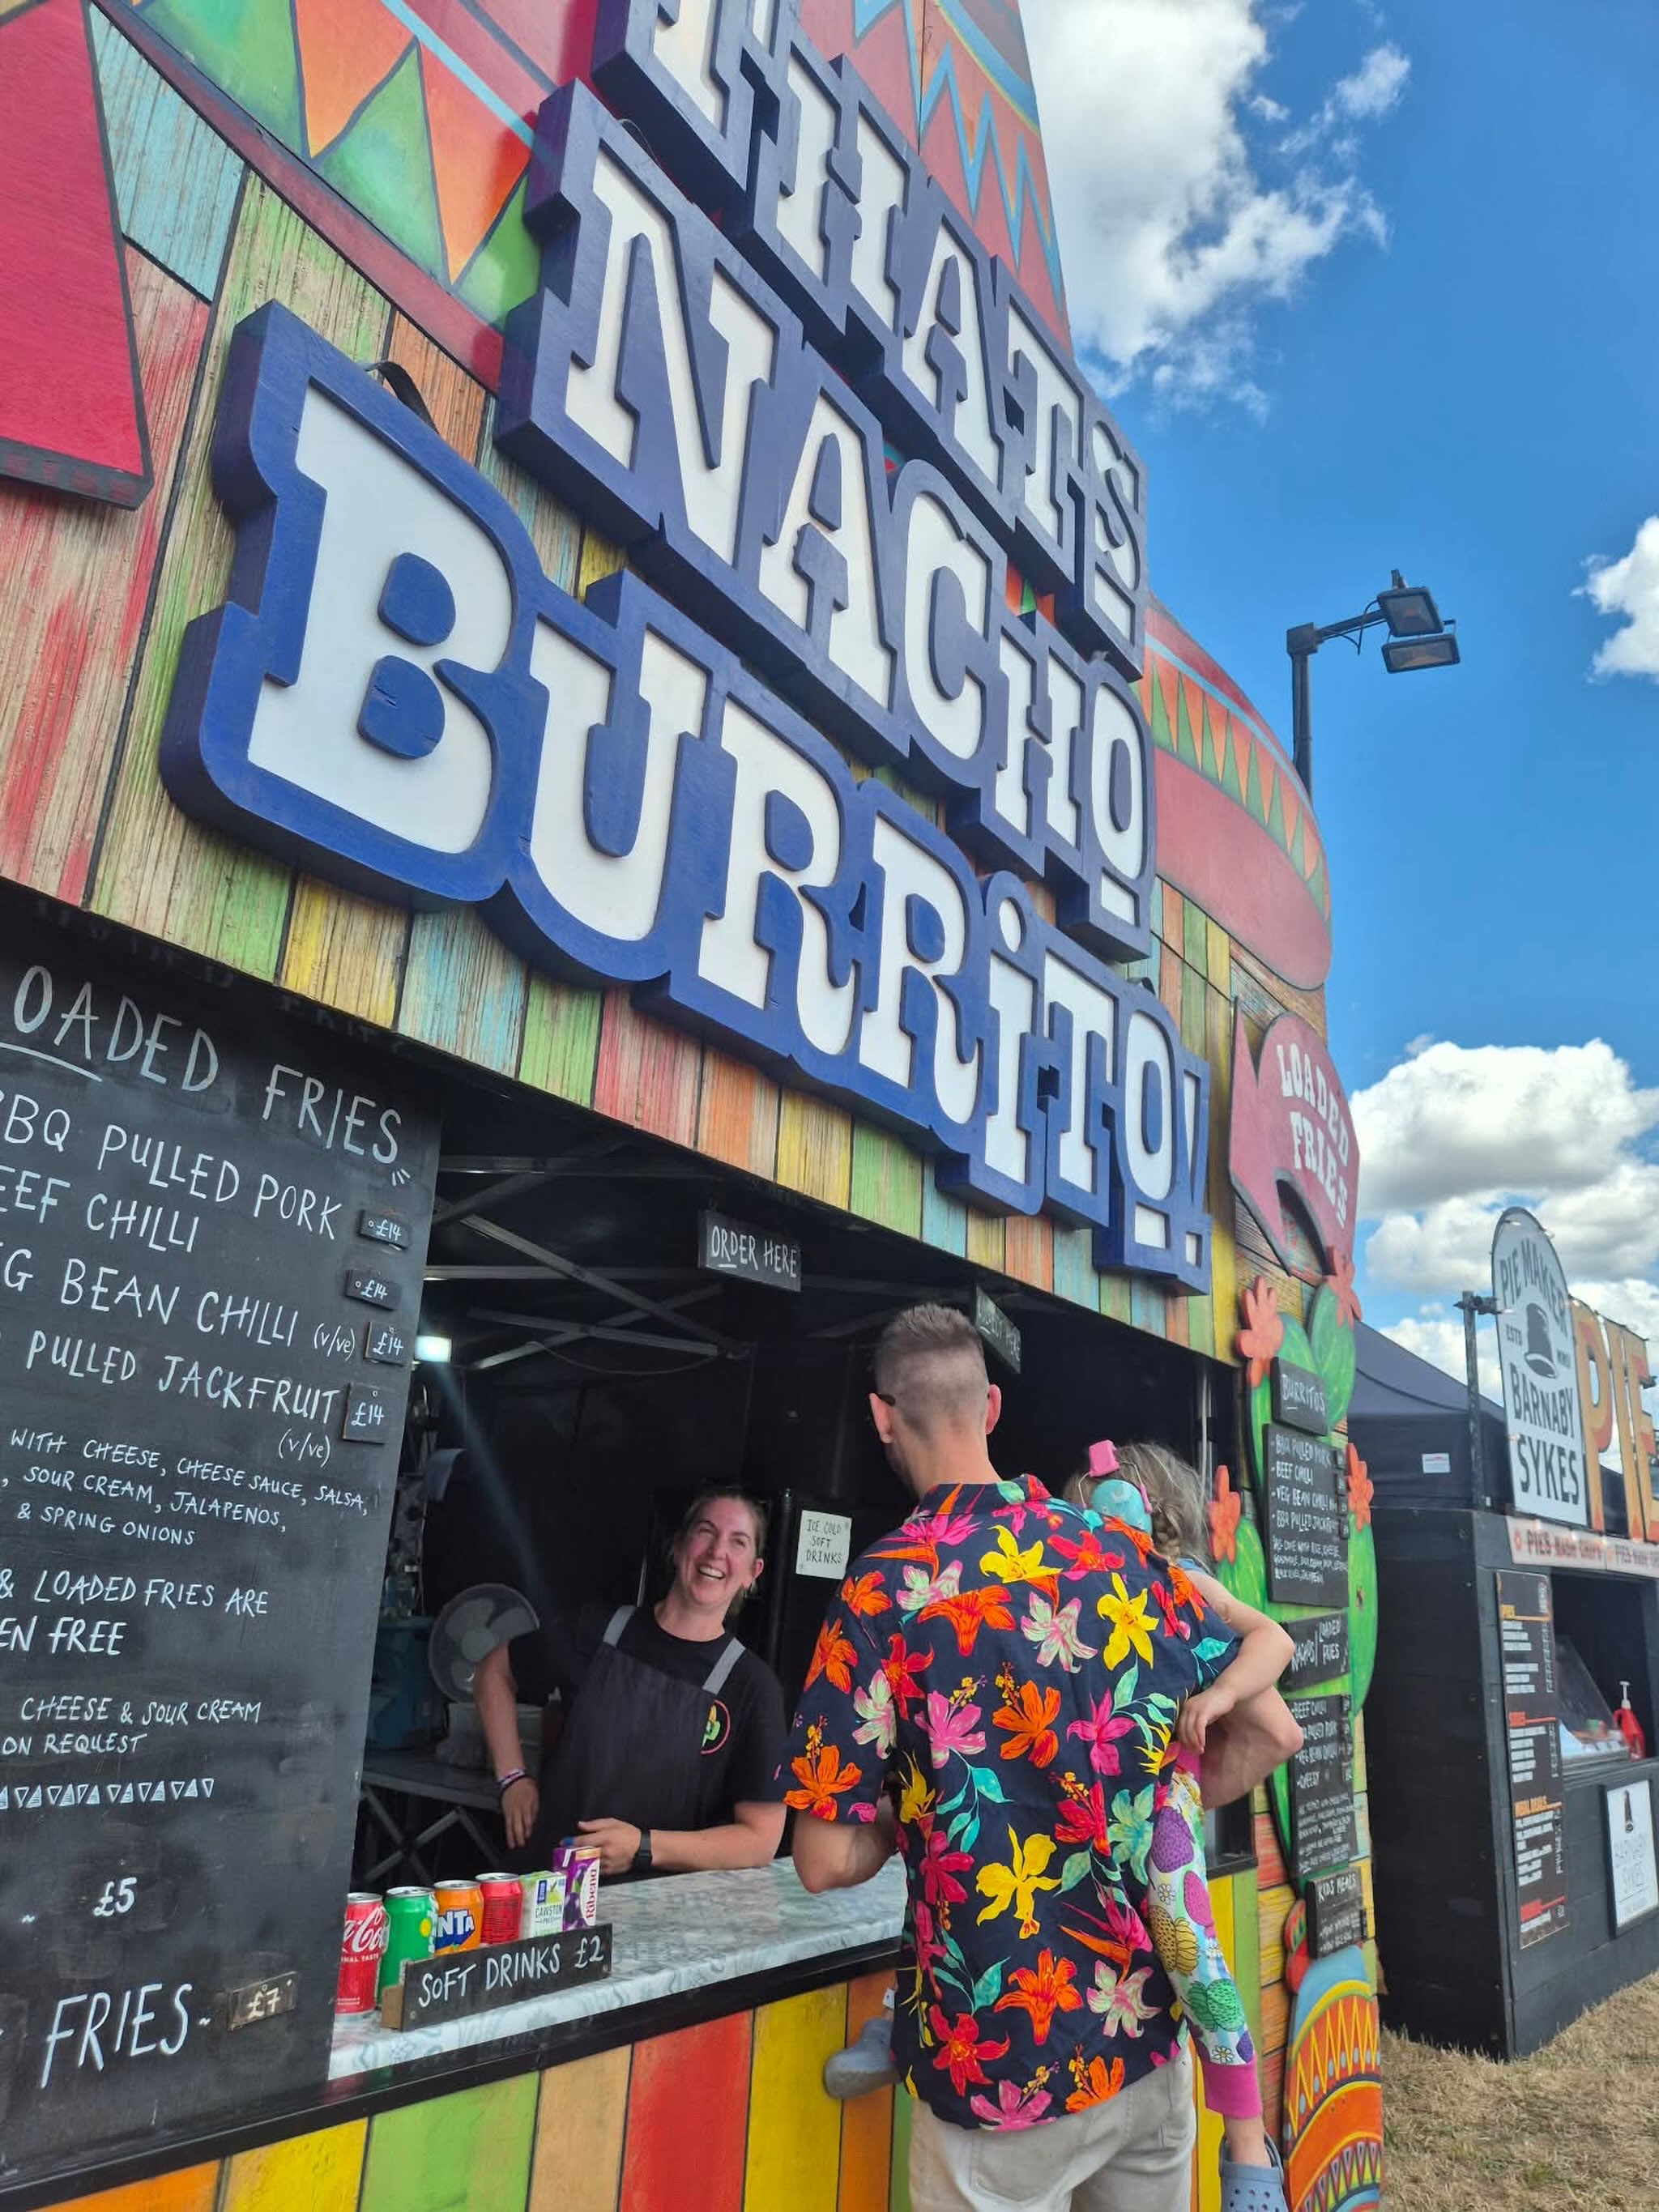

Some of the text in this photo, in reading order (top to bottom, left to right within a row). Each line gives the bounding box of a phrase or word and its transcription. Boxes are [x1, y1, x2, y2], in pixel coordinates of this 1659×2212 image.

[565, 139, 1144, 883] NACHO
[15, 965, 403, 1164] OADED FRIES
[1276, 1042, 1349, 1167] LOADED
[0, 1091, 343, 1239] BQ PULLED PORK
[1290, 1110, 1349, 1228] FRIES
[87, 1193, 199, 1253] CHILLI
[377, 1220, 402, 1242] £14
[711, 1225, 798, 1279] ORDER HERE
[61, 1258, 180, 1324] BEAN
[197, 1290, 299, 1347] CHILLI
[313, 1323, 356, 1362] (v/ve)
[363, 1281, 388, 1301] £14
[1500, 1237, 1568, 1338] PIE MAKER
[372, 1333, 404, 1356] £14
[26, 1329, 340, 1424] PULLED JACKFRUIT
[1281, 1372, 1326, 1417] BURRITOS
[1509, 1362, 1575, 1440] BARNABY
[351, 1401, 386, 1427] £14
[1572, 1298, 1659, 1543] PIE
[11, 1428, 368, 1516] WITH CHEESE, CHEESE SAUCE, SALSA,
[278, 1429, 331, 1468] (v/ve)
[1516, 1434, 1580, 1507] SYKES
[17, 1502, 195, 1546] & SPRING ONIONS
[23, 1466, 287, 1532] SOUR CREAM, JALAPENOS,
[806, 1519, 821, 1532] ICE
[811, 1535, 834, 1549] SOFT
[805, 1549, 842, 1564] DRINKS
[0, 1568, 269, 1617] & LOADED FRIES ARE
[49, 1617, 128, 1656] FREE
[20, 1695, 262, 1725] CHEESE & SOUR CREAM
[2, 1732, 147, 1756] ON REQUEST
[93, 1877, 137, 1917] £5
[586, 1869, 597, 1919] Ribena
[418, 1935, 604, 2008] SOFT DRINKS £2
[247, 1987, 280, 2019] £7
[41, 1983, 194, 2090] FRIES
